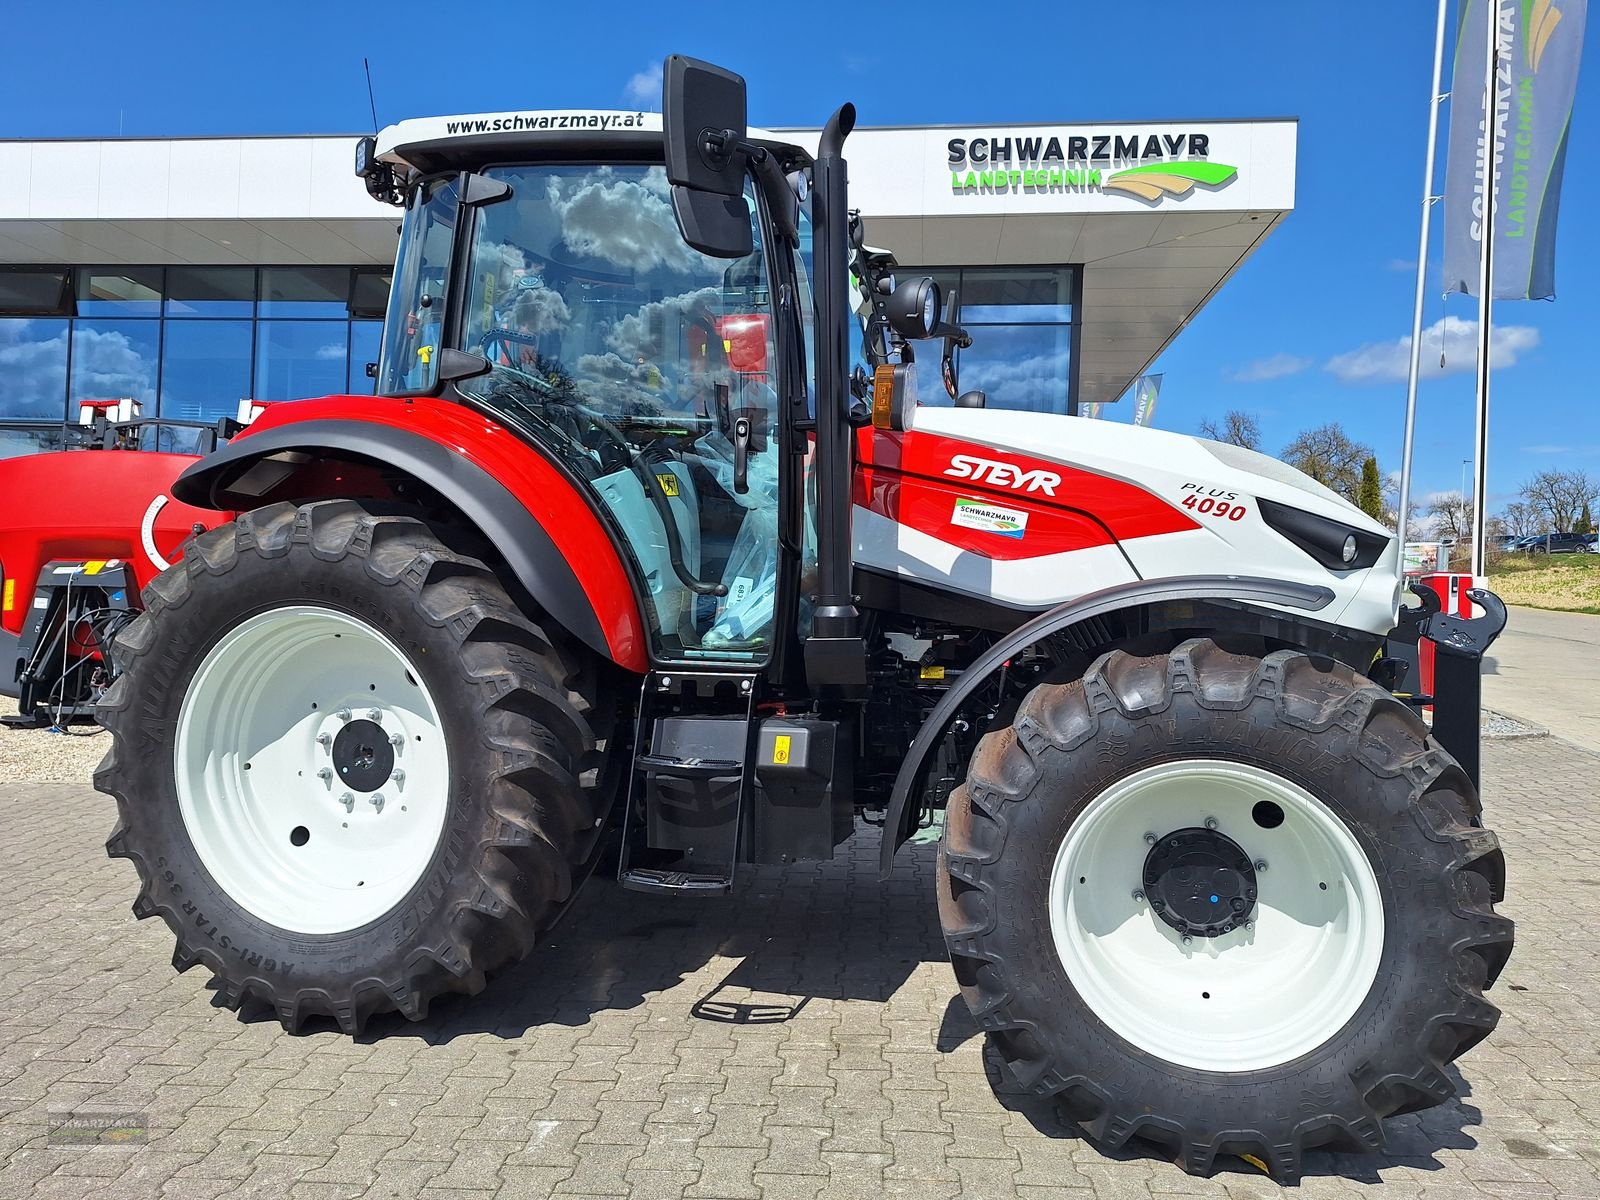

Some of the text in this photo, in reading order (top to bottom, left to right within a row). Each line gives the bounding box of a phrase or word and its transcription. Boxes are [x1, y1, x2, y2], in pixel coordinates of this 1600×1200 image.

[447, 111, 644, 134] www.schwarzmayr.at
[947, 133, 1209, 163] SCHWARZMAYR
[1504, 75, 1534, 238] LANDTECHNIK
[952, 168, 1102, 190] LANDTECHNIK
[943, 454, 1062, 497] STEYR
[1181, 482, 1239, 501] PLUS
[960, 505, 1017, 523] SCHWARZMAYR
[1181, 494, 1247, 522] 4090
[156, 856, 296, 977] AGRI-STAR 365
